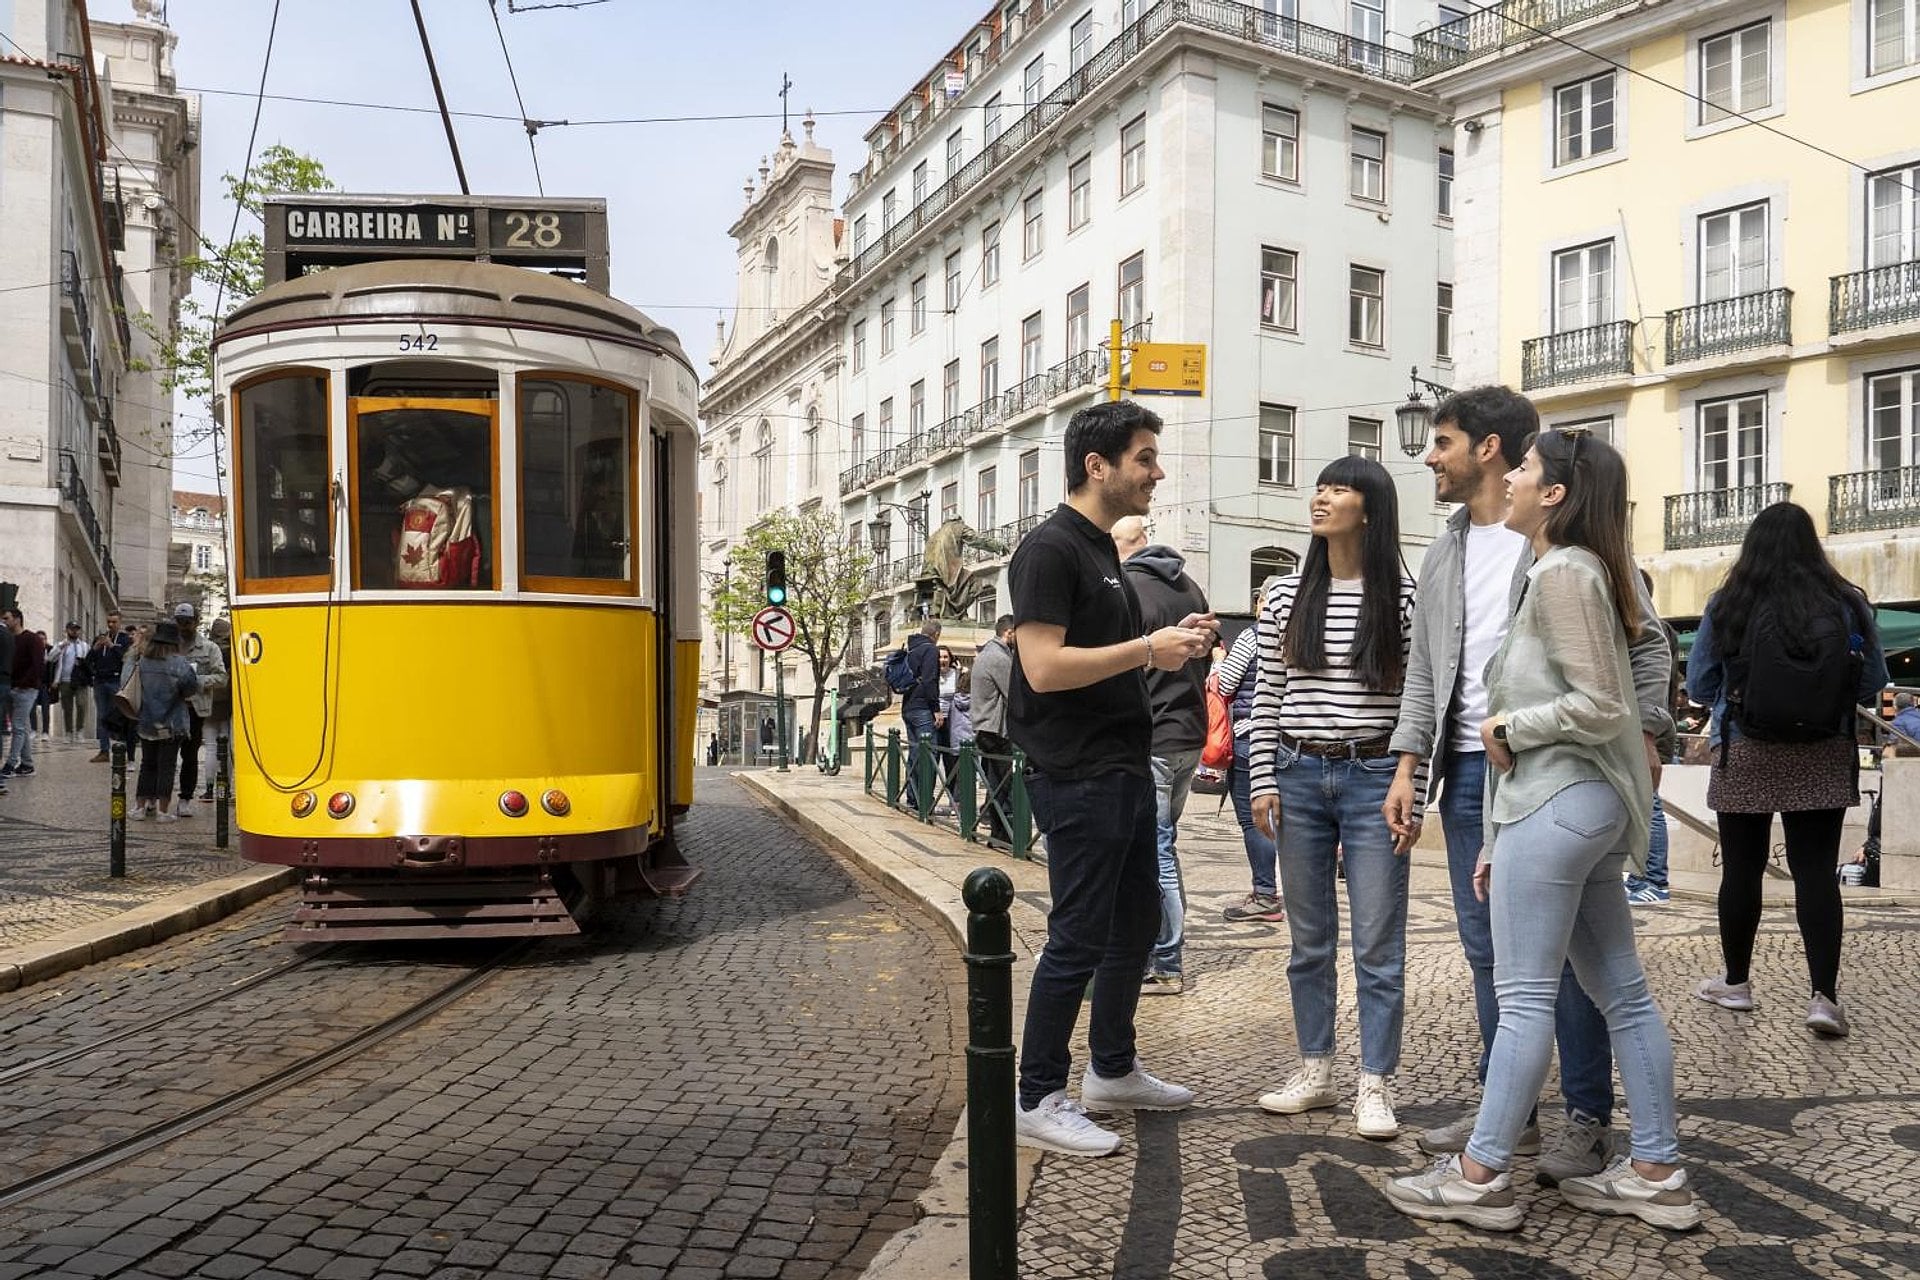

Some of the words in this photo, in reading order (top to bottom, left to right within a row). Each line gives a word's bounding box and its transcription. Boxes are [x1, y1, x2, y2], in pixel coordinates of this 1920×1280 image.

[288, 210, 421, 240] CARREIRA
[506, 212, 561, 248] 28
[399, 334, 438, 351] 542
